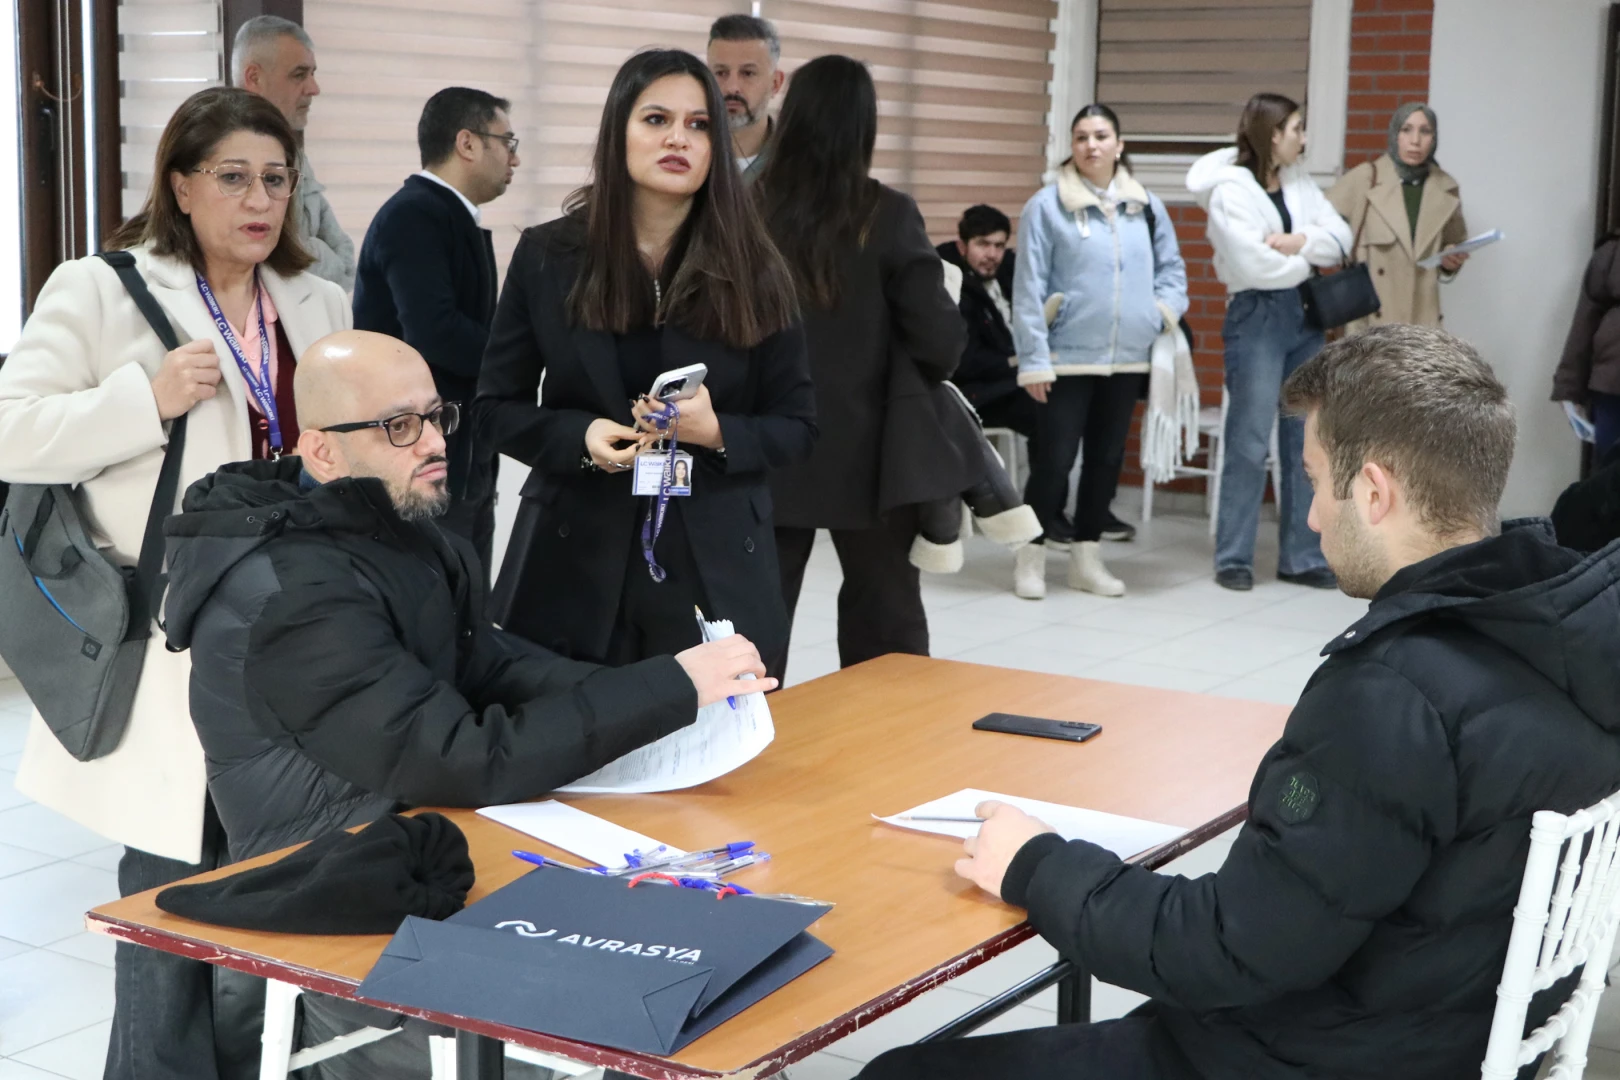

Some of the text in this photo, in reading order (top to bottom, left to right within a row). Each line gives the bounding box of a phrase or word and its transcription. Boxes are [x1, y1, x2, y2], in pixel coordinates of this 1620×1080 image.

[200, 282, 209, 292] LC
[215, 316, 228, 330] LC
[557, 933, 702, 962] AVRASYA
